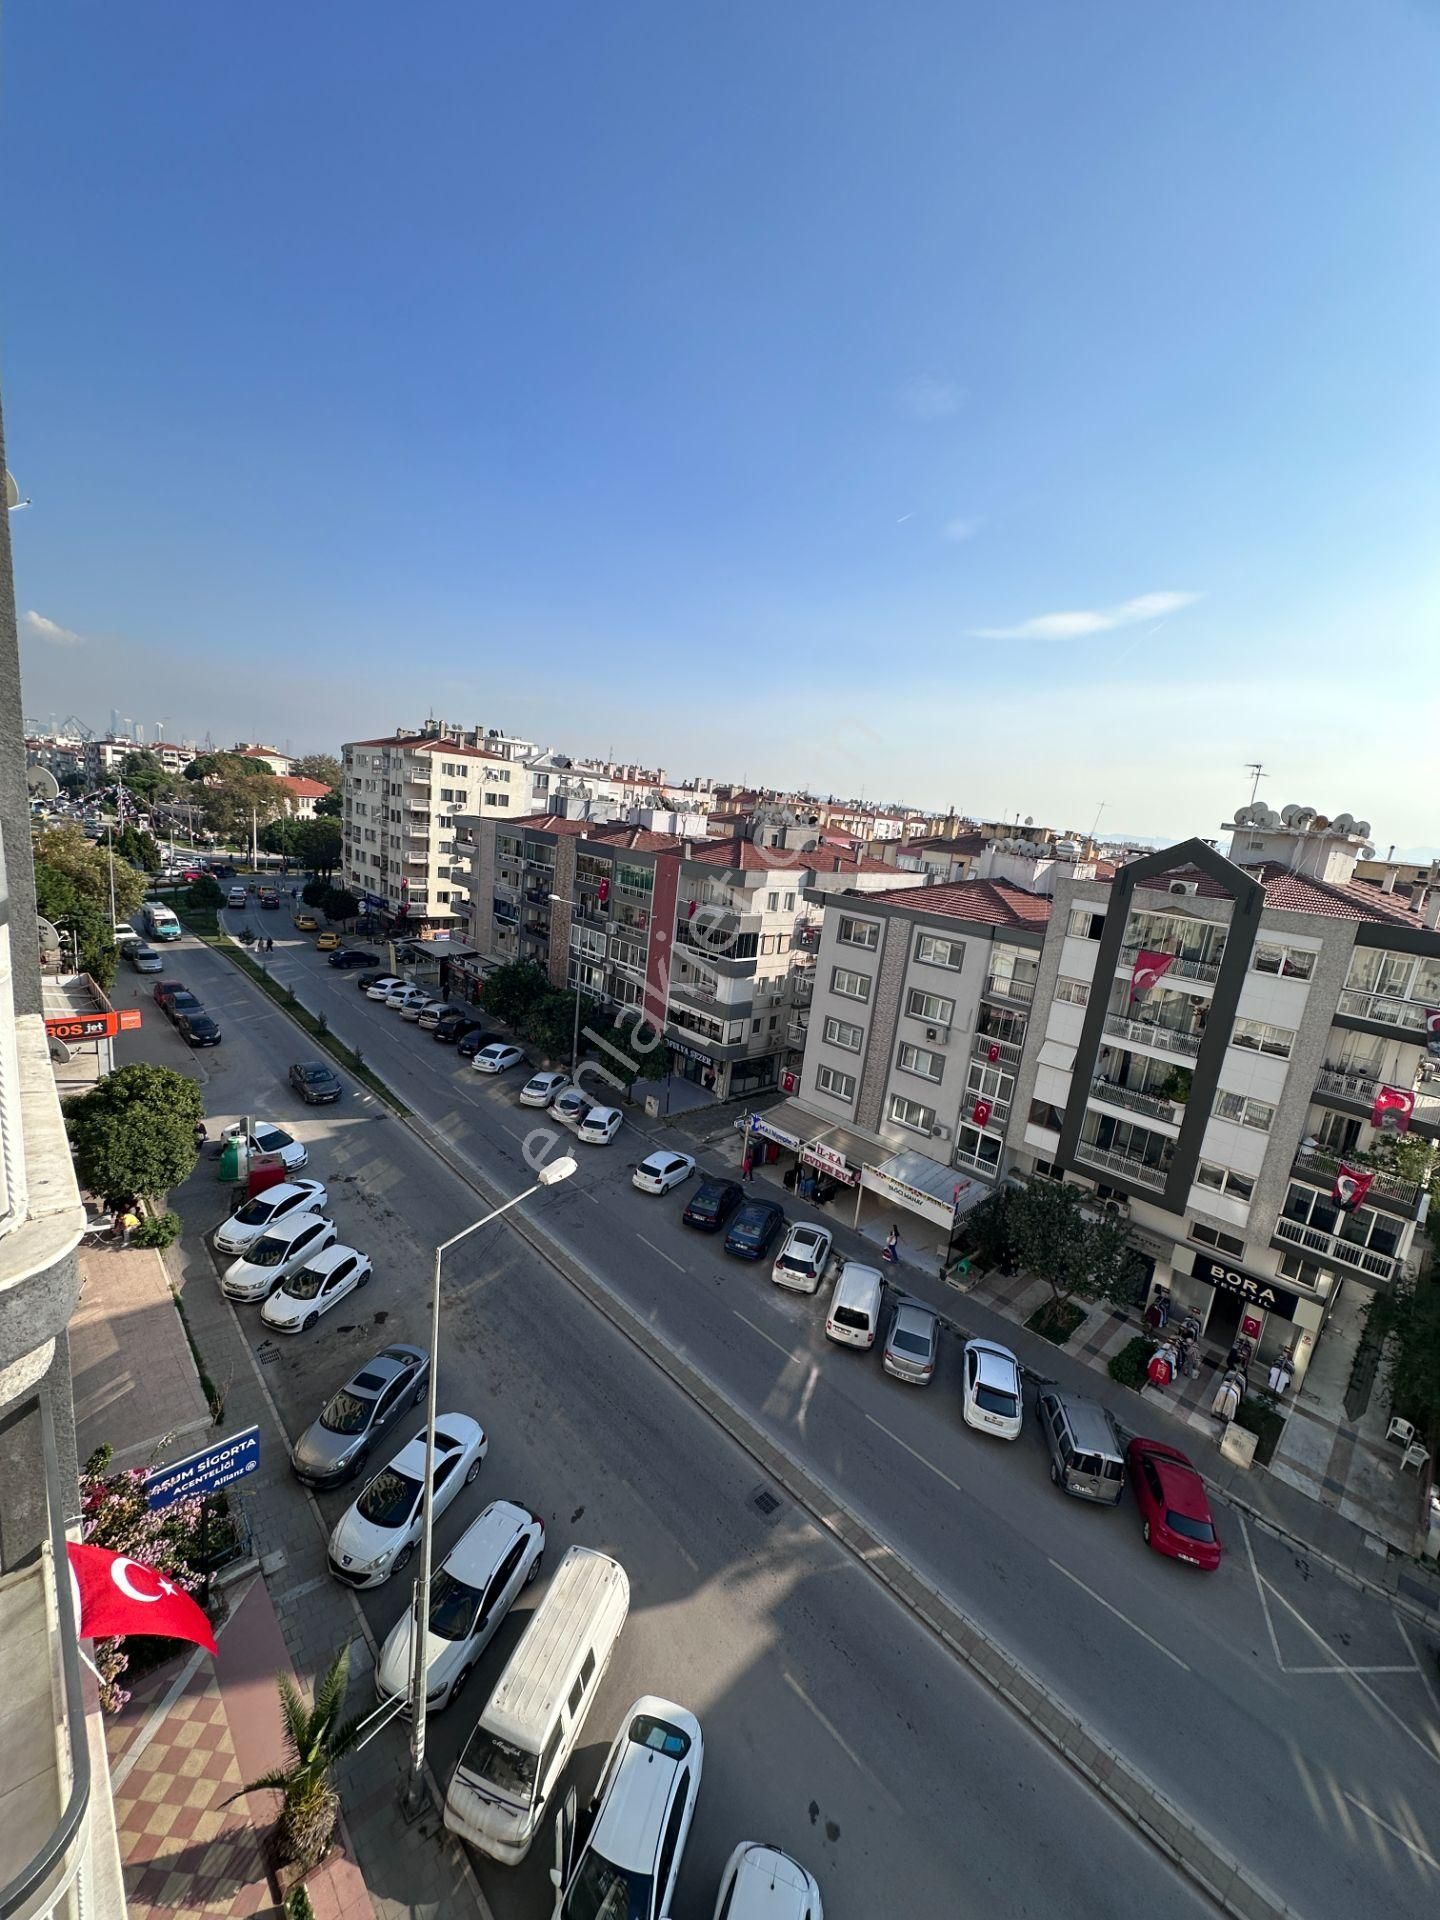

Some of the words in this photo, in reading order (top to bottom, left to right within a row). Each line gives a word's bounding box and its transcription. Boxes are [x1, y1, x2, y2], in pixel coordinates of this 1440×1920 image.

[804, 1152, 834, 1174] EVDEN
[1210, 1264, 1276, 1303] BORA
[197, 1438, 257, 1473] SİGORTA
[213, 1468, 245, 1488] Allianz
